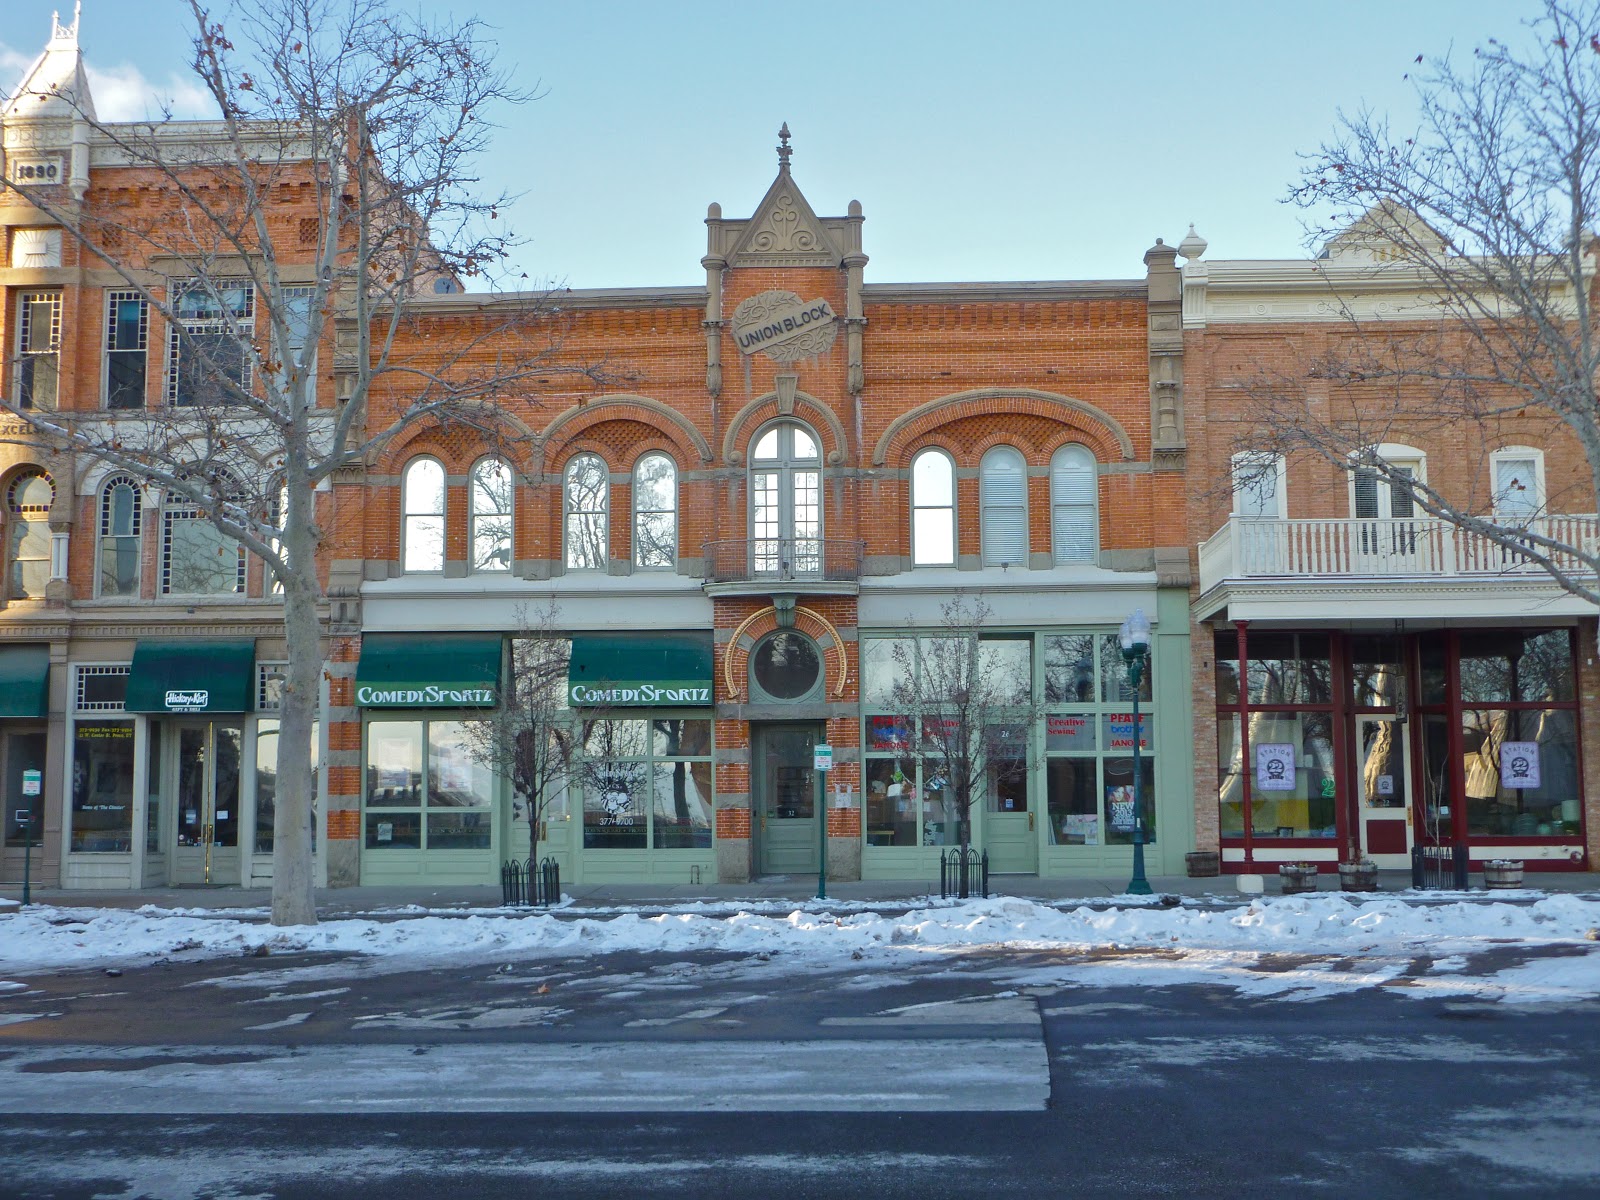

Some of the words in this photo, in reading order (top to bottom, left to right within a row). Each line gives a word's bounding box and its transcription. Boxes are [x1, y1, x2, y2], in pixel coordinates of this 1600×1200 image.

[17, 164, 57, 178] 1890
[738, 322, 784, 348] UNION
[783, 303, 830, 332] BLOCK
[1048, 717, 1085, 727] Creative
[1047, 727, 1076, 736] Sewing
[1260, 748, 1291, 758] STATION
[1504, 746, 1535, 756] STATION
[1268, 762, 1283, 773] 22
[1512, 760, 1527, 771] 22
[1111, 802, 1135, 810] NEW
[599, 817, 634, 826] 377-9700
